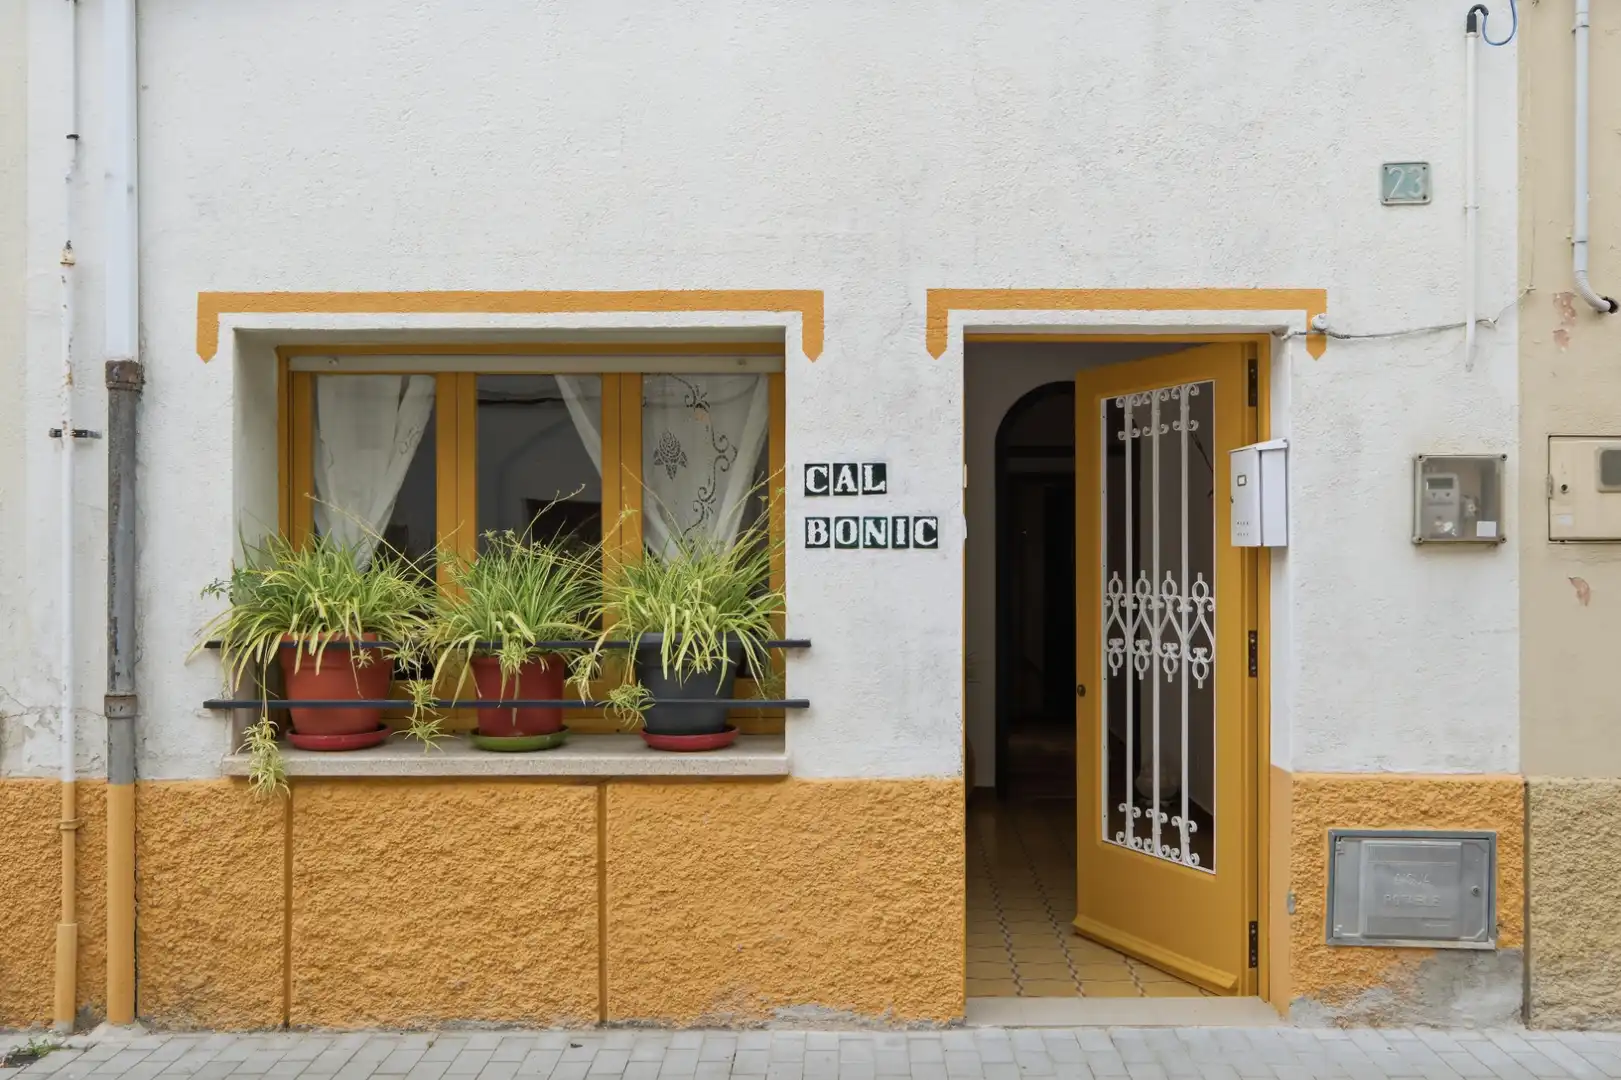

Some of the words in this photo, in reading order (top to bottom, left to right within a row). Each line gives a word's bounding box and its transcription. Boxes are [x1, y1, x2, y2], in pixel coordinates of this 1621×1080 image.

[1388, 166, 1424, 199] 23
[805, 464, 887, 493] CAL
[806, 518, 938, 546] BONIC
[1383, 893, 1442, 907] POTABLE
